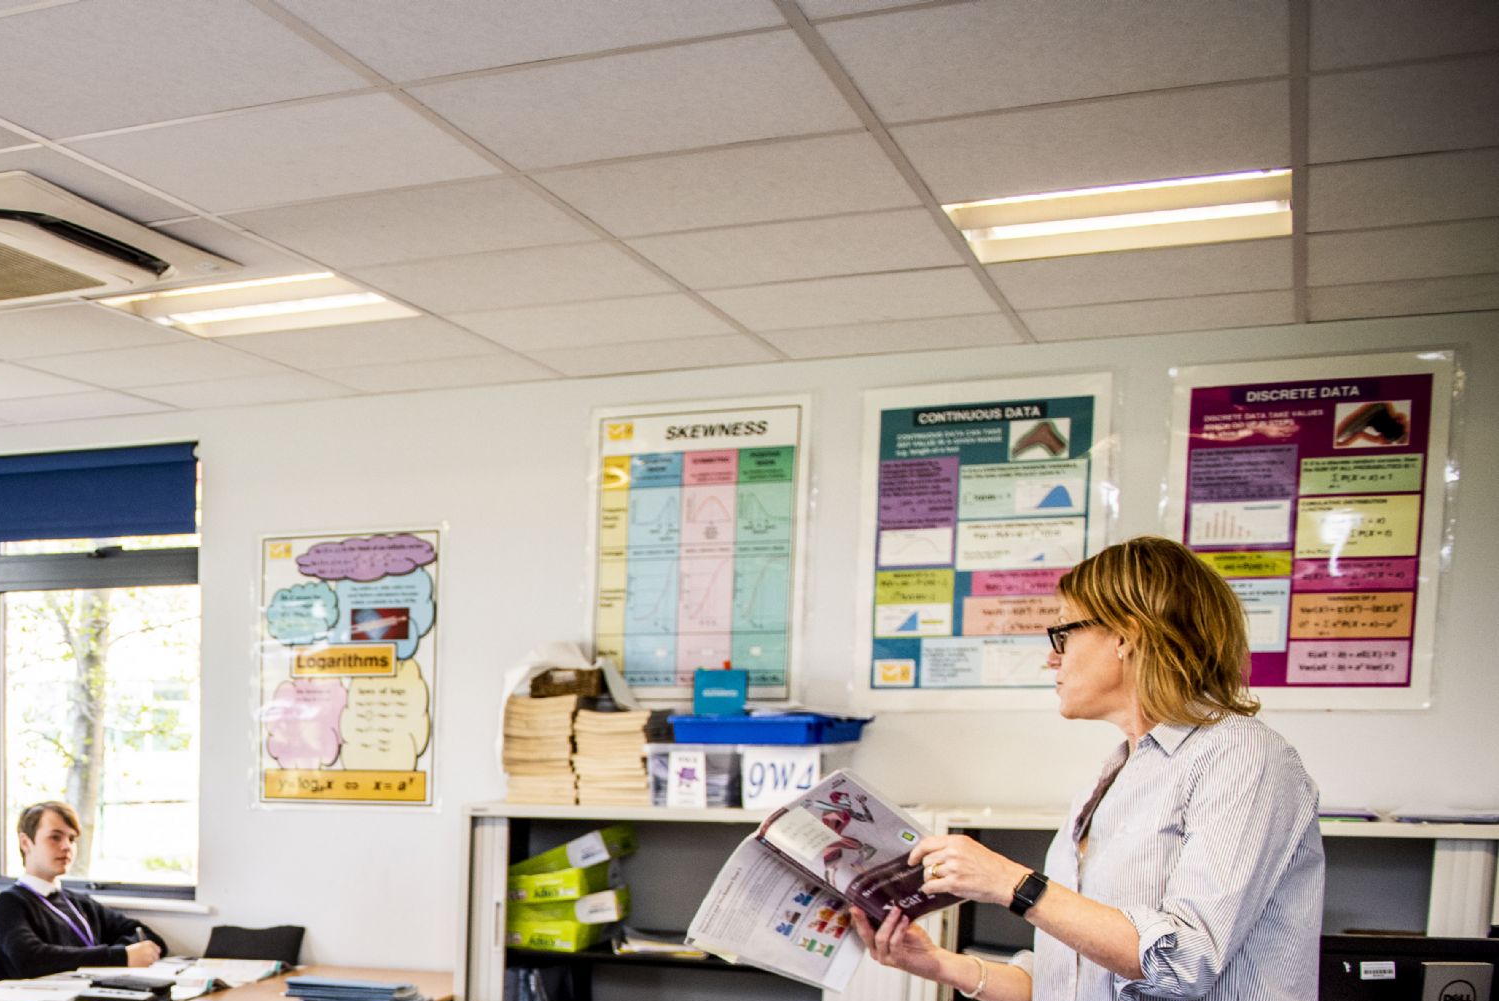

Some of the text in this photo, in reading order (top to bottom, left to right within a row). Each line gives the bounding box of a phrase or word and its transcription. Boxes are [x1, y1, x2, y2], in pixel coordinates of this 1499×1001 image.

[1246, 385, 1360, 403] DISCRETE DATA
[917, 404, 1041, 425] CONTINUOUS DATA
[1204, 408, 1324, 422] DISCRETE DATA TAKE VALUES
[665, 420, 769, 441] SKEWNESS
[296, 652, 390, 671] Logarithms
